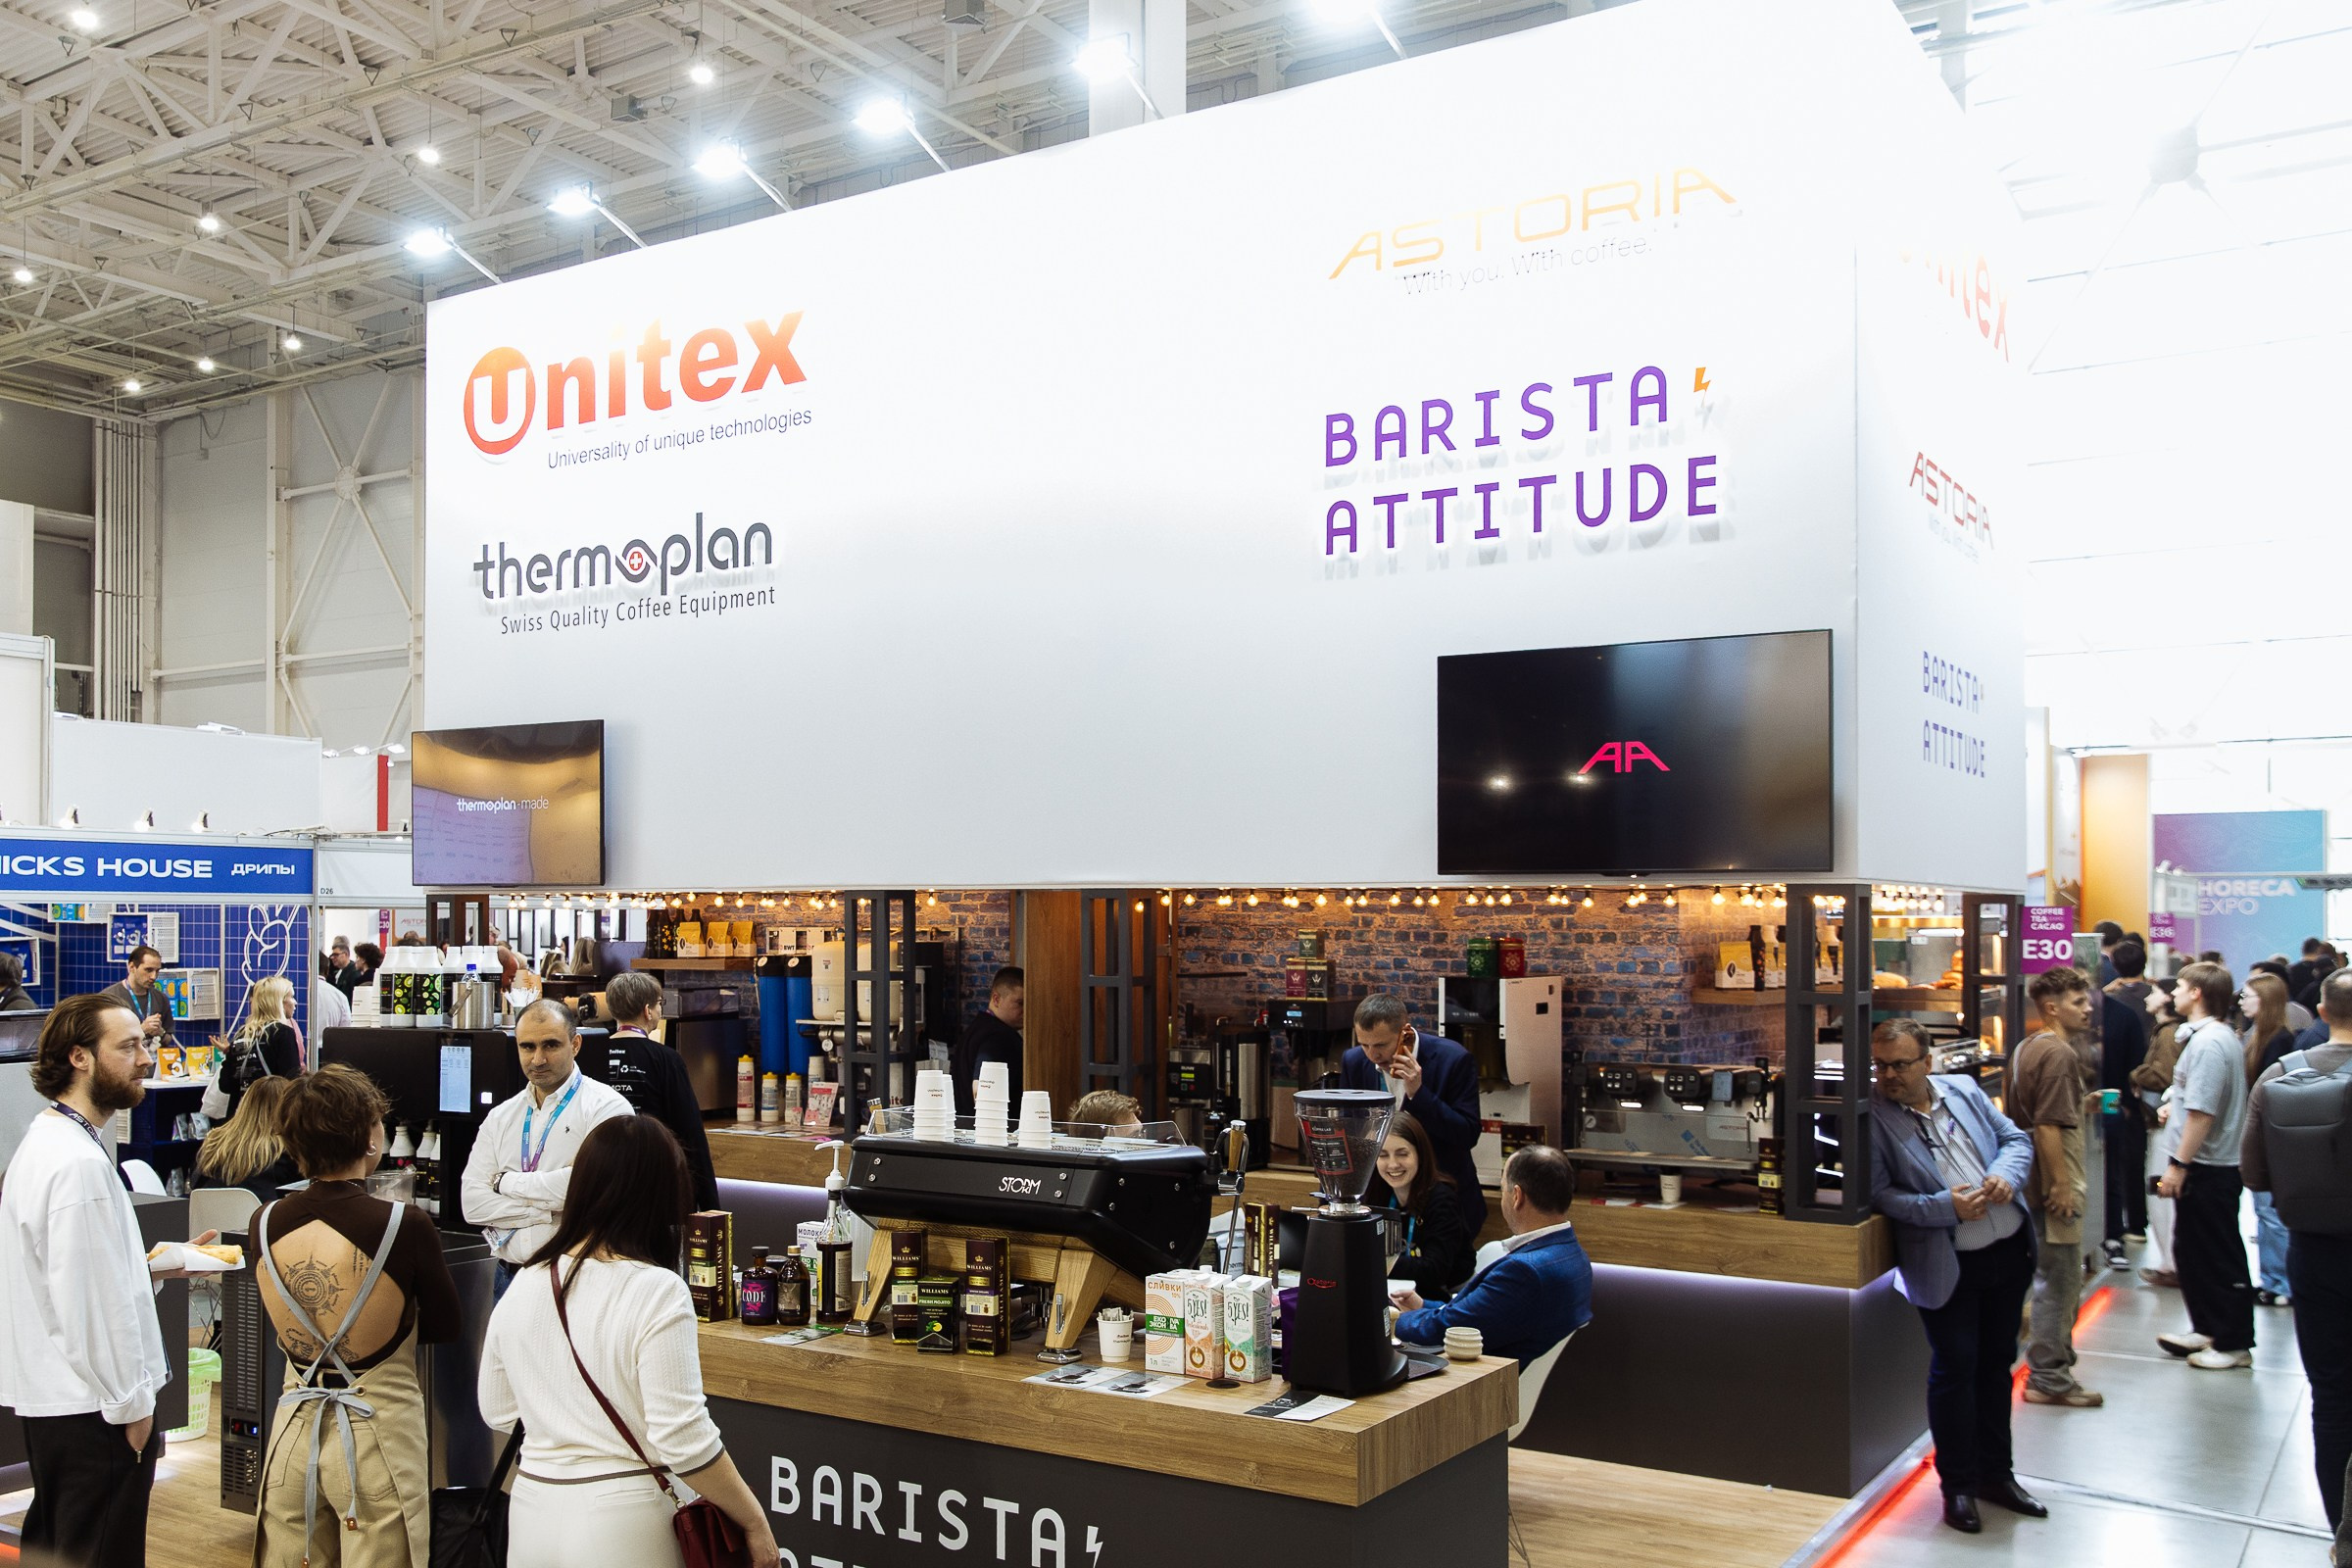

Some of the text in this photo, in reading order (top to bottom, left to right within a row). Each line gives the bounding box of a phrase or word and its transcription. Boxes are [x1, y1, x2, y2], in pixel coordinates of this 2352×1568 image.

[1329, 167, 1737, 280] ASTORIA
[464, 311, 807, 456] Unitex
[548, 408, 812, 469] Universality of unique technologies
[1326, 366, 1668, 467] BARISTA
[1326, 456, 1717, 556] ATTITUDE
[1910, 451, 1994, 551] ASTORIA
[473, 513, 772, 600] thermoplan
[501, 586, 776, 635] Swiss Quality Coffee Equipment
[1923, 650, 1979, 714] BARISTA
[1923, 719, 1985, 778] ATTITUDE
[0, 855, 213, 879] ICKS HOUSE
[230, 862, 295, 876] ДРИПЫ
[320, 887, 334, 896] D26
[2197, 878, 2297, 898] HORECA
[2030, 907, 2064, 916] COFFEE
[2030, 922, 2066, 931] CACAO
[2197, 897, 2259, 916] EXPO
[2022, 939, 2074, 960] E30
[999, 1176, 1042, 1195] STORM
[771, 1455, 1066, 1568] BARISTA
